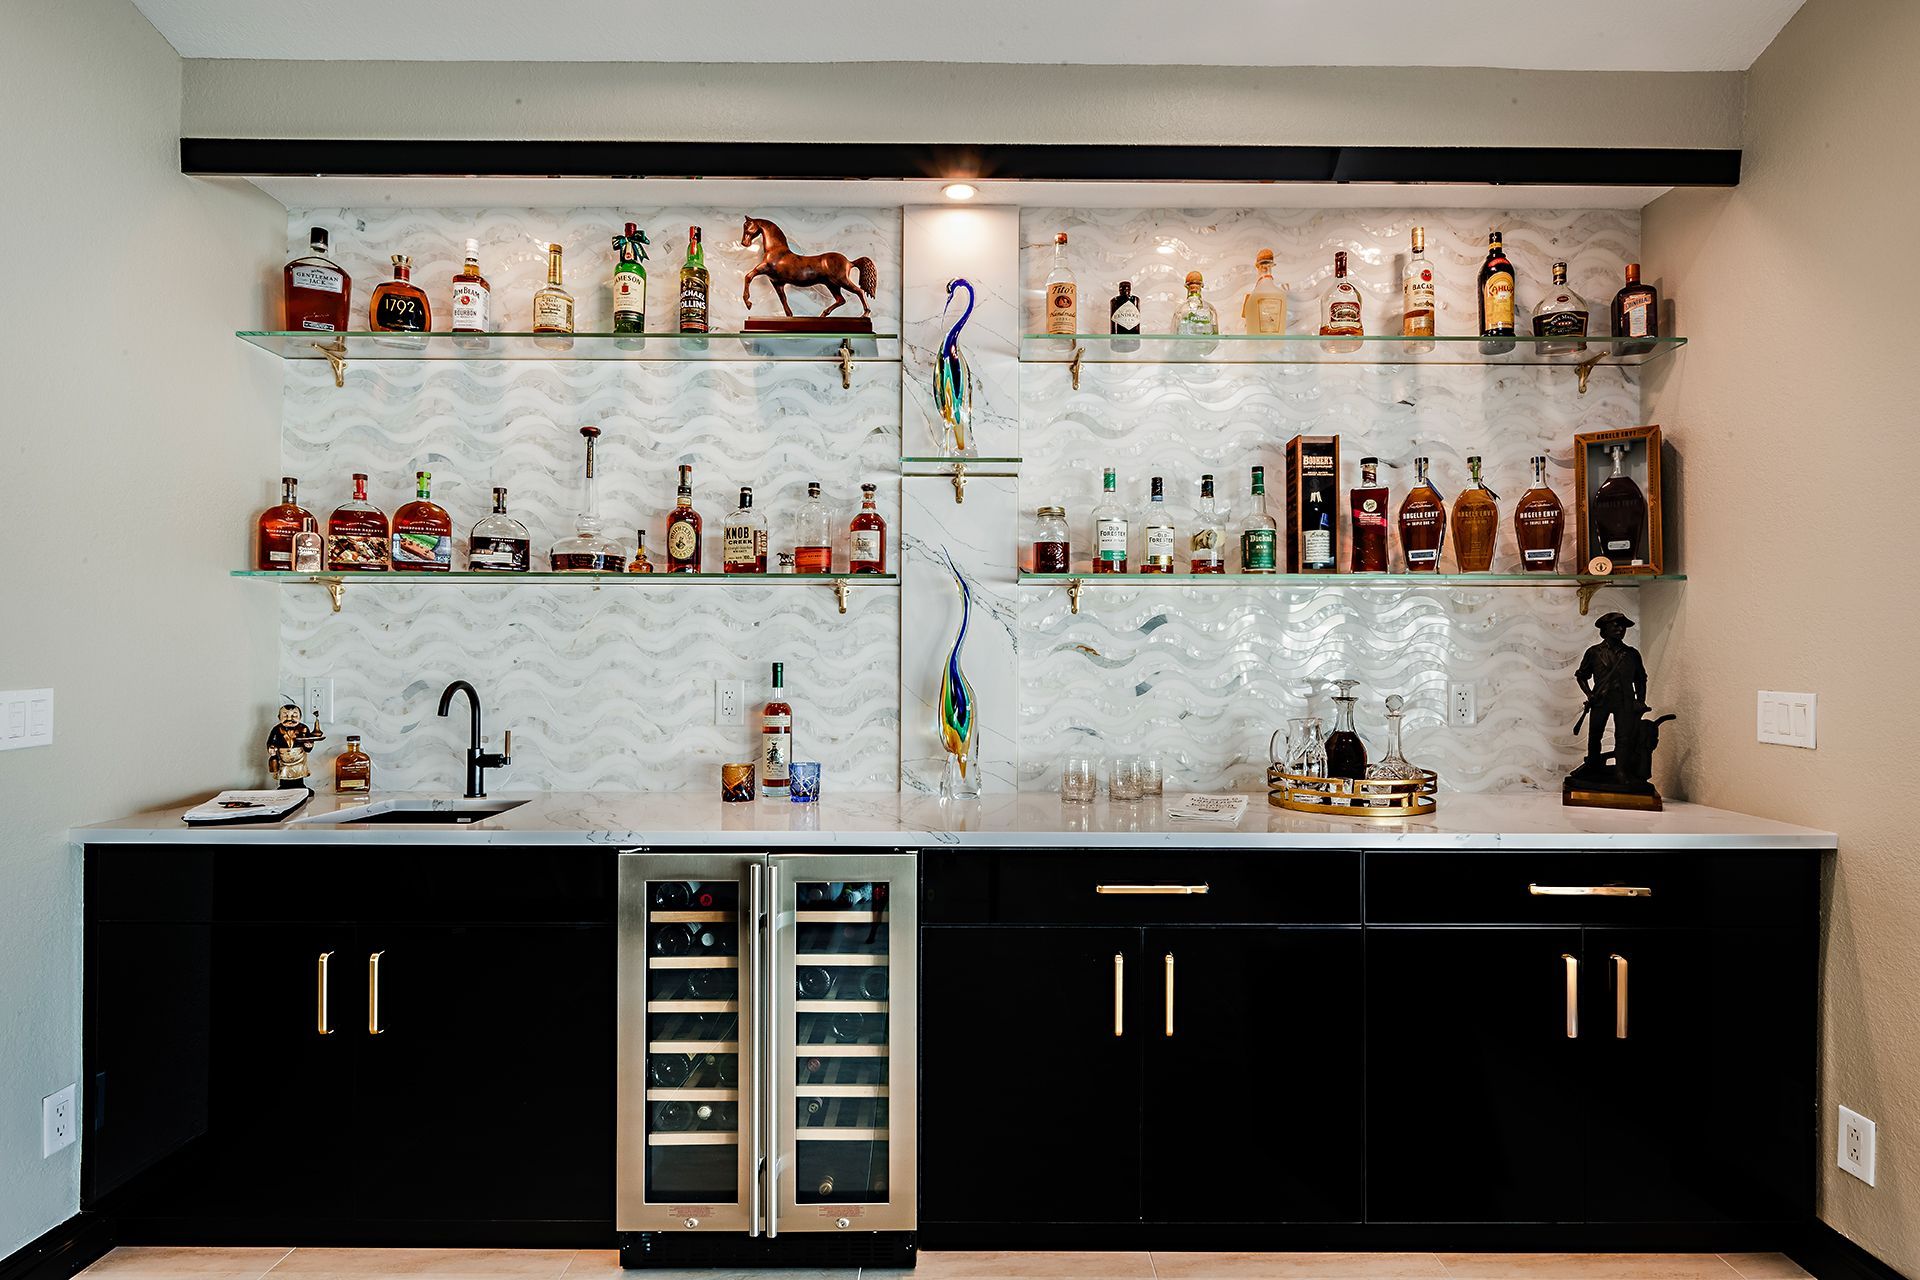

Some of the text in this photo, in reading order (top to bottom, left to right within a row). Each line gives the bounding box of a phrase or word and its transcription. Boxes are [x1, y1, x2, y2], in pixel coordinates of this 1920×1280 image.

[296, 271, 339, 282] GENTLEMAN
[614, 275, 641, 286] JAMESON
[309, 278, 326, 286] JACK
[1412, 283, 1434, 291] BACAR
[463, 286, 480, 299] BEAM
[1052, 285, 1075, 295] Tito's
[385, 298, 415, 315] 1792
[680, 300, 706, 310] OLLINS
[454, 309, 477, 317] BOURBON
[726, 526, 749, 539] KNOB
